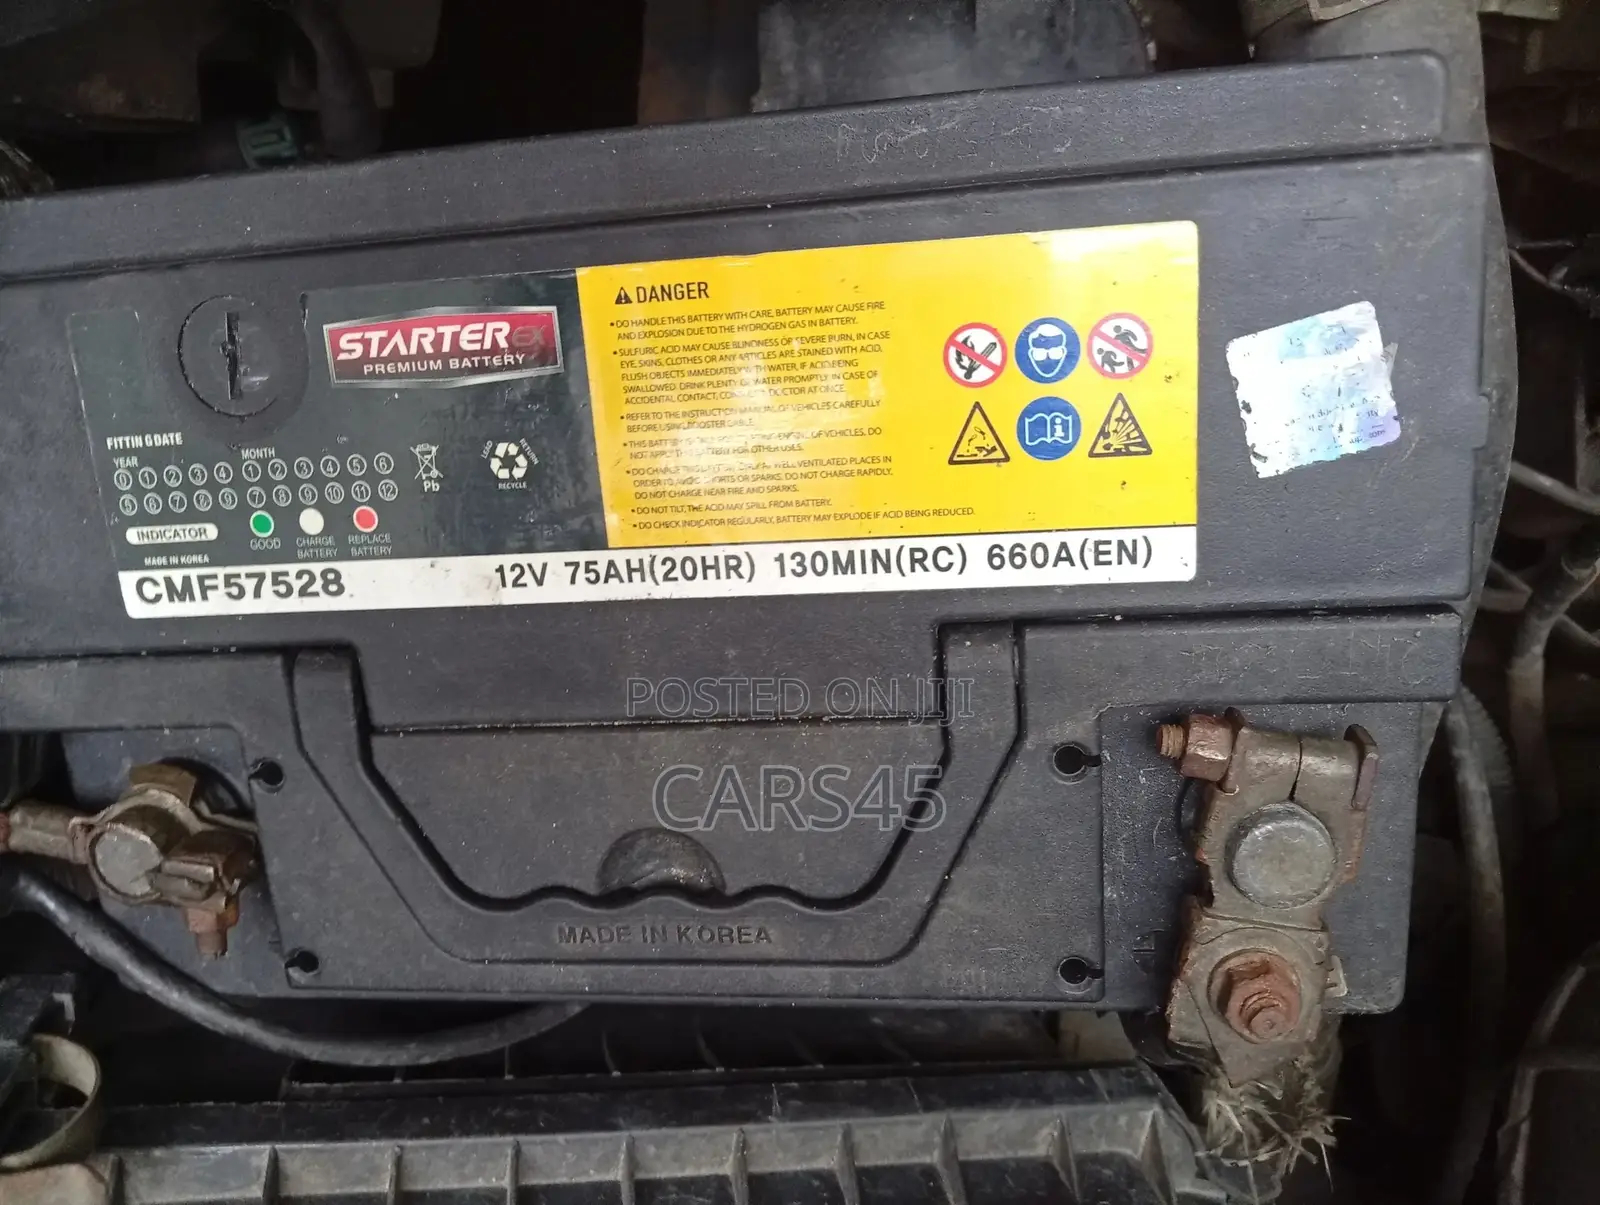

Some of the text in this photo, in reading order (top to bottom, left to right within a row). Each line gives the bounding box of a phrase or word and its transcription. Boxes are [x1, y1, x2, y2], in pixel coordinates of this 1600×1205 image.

[636, 282, 710, 303] DANGER
[615, 319, 629, 328] DO
[630, 316, 666, 327] HANDLE
[666, 315, 685, 324] THIS
[687, 312, 723, 323] BATTERY
[725, 310, 747, 320] WITH
[775, 306, 812, 316] BATTERY
[814, 304, 833, 314] MAY
[835, 302, 864, 312] CAUSE
[866, 301, 885, 310] FIRE
[617, 331, 635, 340] AND
[637, 328, 684, 339] EXPLOSION
[686, 326, 703, 335] DUE
[705, 325, 717, 334] TO
[719, 324, 735, 333] THE
[737, 321, 786, 332] HYDROGEN
[788, 319, 806, 329] GAS
[808, 319, 817, 327] IN
[337, 321, 510, 360] STARTER
[618, 346, 658, 356] SULFURIC
[660, 344, 680, 354] ACID
[682, 343, 701, 352] MAY
[702, 341, 729, 351] CAUSE
[731, 338, 778, 349] BLINDNESS
[780, 337, 792, 346] OR
[856, 332, 865, 340] IN
[867, 330, 890, 340] CASE
[364, 354, 525, 375] PREMIUM BATTERY
[665, 355, 702, 365] CLOTHES
[704, 354, 716, 363] OR
[718, 353, 735, 362] ANY
[779, 349, 796, 358] ARE
[797, 347, 833, 357] STAINED
[834, 345, 857, 354] WITH
[621, 371, 648, 381] FLUSH
[649, 369, 685, 379] OBJECTS
[687, 366, 738, 377] IMMEDIATELY
[800, 361, 807, 370] IF
[809, 360, 830, 369] ACID
[831, 358, 858, 368] BEING
[679, 381, 704, 390] DRINK
[706, 379, 736, 388] PLENTY
[754, 376, 781, 385] WATER
[783, 373, 827, 384] PROMPTLY
[831, 372, 840, 381] IN
[842, 371, 865, 380] CASE
[866, 370, 878, 378] OF
[624, 394, 675, 405] ACCIDENTAL
[807, 385, 818, 394] AT
[625, 398, 880, 421] REFER TO THE CAREFULLY
[626, 423, 658, 433] BEFORE
[811, 430, 822, 438] OF
[867, 427, 881, 435] DO
[241, 447, 275, 460] MONTH
[481, 440, 493, 459] LEAD
[520, 438, 539, 465] RETURN
[113, 456, 138, 468] YEAR
[631, 455, 892, 476] DO VENTILATED PLACES IN
[424, 480, 440, 492] Pb
[498, 482, 527, 490] RECYCLE
[633, 478, 661, 487] ORDER
[737, 474, 749, 482] OR
[784, 471, 798, 480] DO
[800, 471, 818, 479] NOT
[820, 469, 856, 478] CHARGE
[634, 491, 648, 499] DO
[650, 490, 667, 498] NOT
[668, 488, 701, 498] CHARGE
[704, 487, 726, 496] NEAR
[728, 486, 744, 495] FIRE
[746, 485, 764, 494] AND
[636, 506, 649, 514] DO
[651, 505, 668, 514] NOT
[687, 503, 703, 512] THE
[704, 502, 724, 511] ACID
[726, 502, 744, 510] MAY
[745, 501, 767, 509] SPILL
[768, 499, 793, 509] FROM
[638, 521, 651, 529] DO
[653, 519, 681, 529] CHECK
[682, 517, 726, 527] INDICATOR
[776, 514, 812, 523] BATTERY
[813, 513, 832, 522] MAY
[833, 511, 872, 521] EXPLODE
[873, 511, 881, 519] IF
[882, 510, 903, 519] ACID
[904, 508, 930, 518] BEING
[136, 527, 208, 542] INDICATOR
[250, 537, 281, 550] GOOD
[296, 536, 336, 547] CHARGE
[348, 533, 392, 544] REPLACE
[144, 554, 210, 566] MADE IN KOREA
[297, 548, 338, 560] BATTERY
[350, 545, 392, 556] BATTERY
[494, 535, 1153, 588] 12V 75AH(20HR) 130MIN(RC) 660A(EN)
[136, 568, 345, 604] CMF57528
[558, 924, 772, 944] MADE IN KOREA
